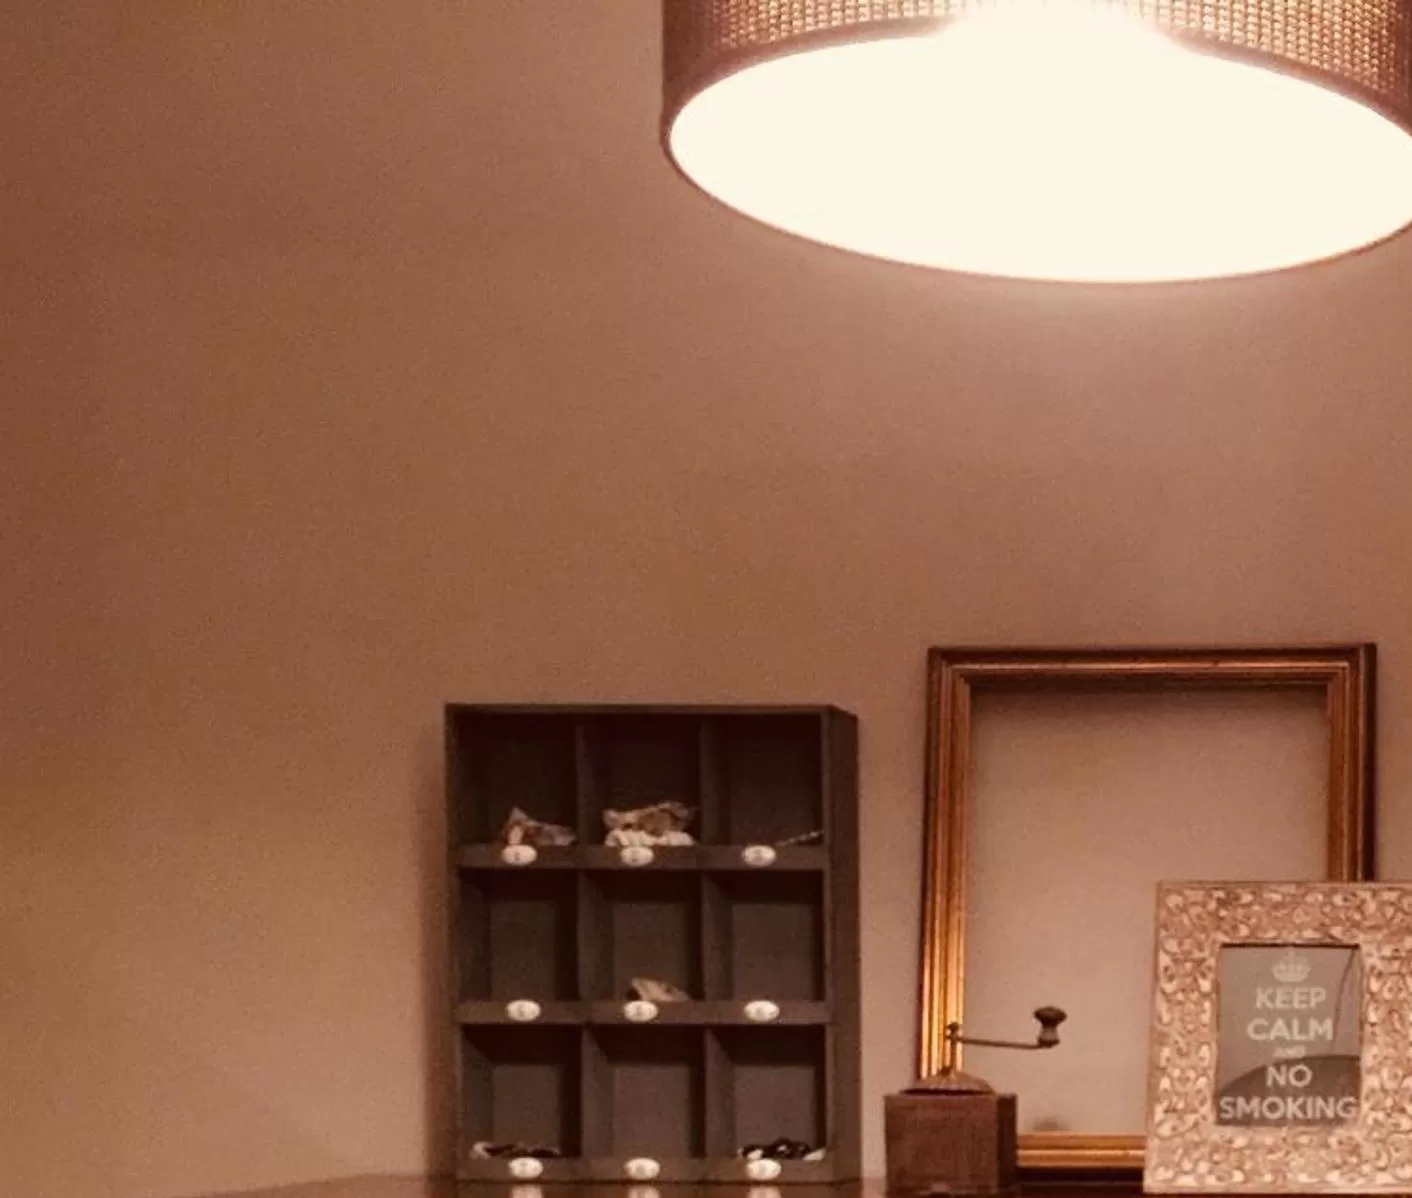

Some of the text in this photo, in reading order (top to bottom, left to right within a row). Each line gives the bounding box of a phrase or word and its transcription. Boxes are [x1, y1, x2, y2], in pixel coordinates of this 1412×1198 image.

[1255, 986, 1326, 1009] KEEP
[1247, 1017, 1333, 1040] CALM
[1266, 1063, 1313, 1087] NO
[1219, 1096, 1357, 1119] SMOKING
